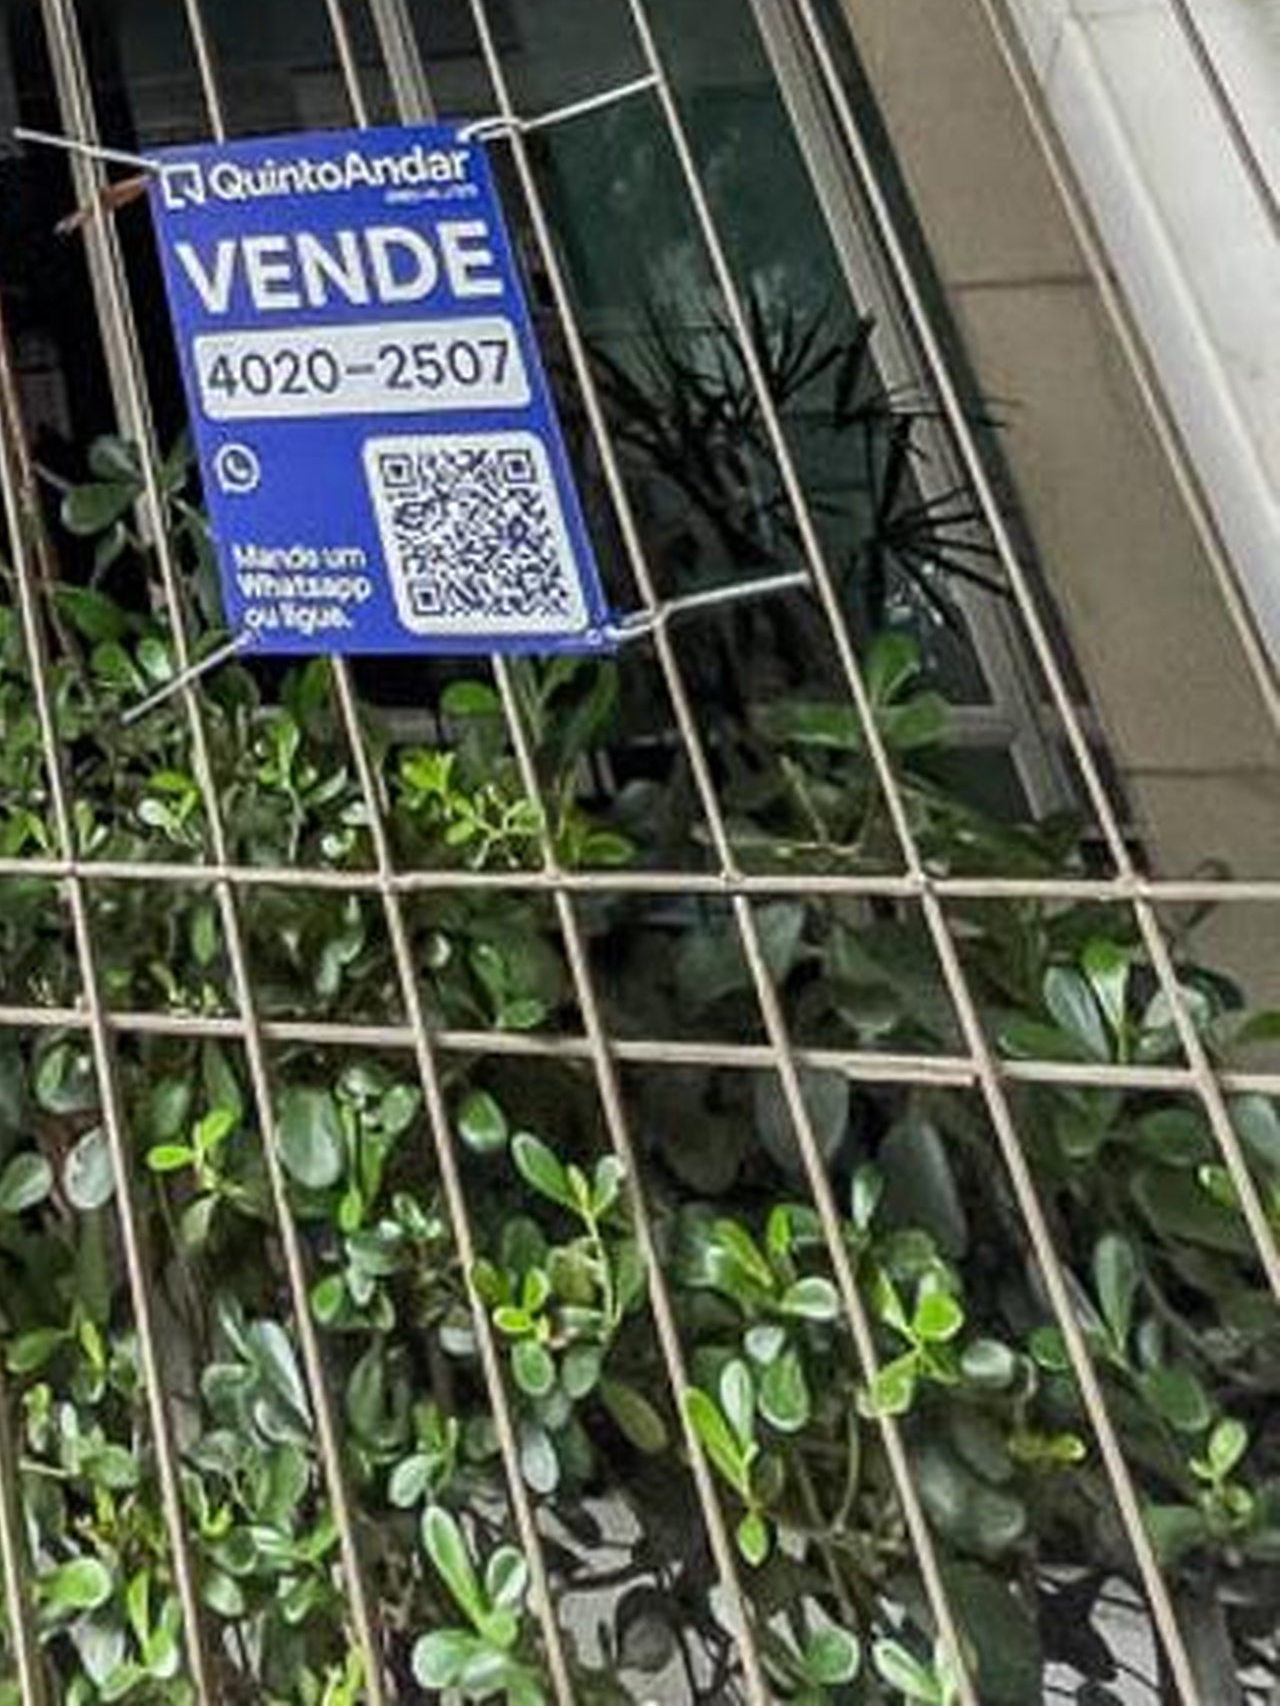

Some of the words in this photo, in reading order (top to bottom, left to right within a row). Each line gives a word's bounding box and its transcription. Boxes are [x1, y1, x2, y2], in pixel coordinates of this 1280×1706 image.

[208, 144, 471, 201] QuintoAndar
[173, 219, 505, 315] VENDE
[206, 338, 510, 398] 4020-2507
[231, 543, 318, 570] Mande
[322, 546, 367, 570] um
[243, 606, 279, 630] ou
